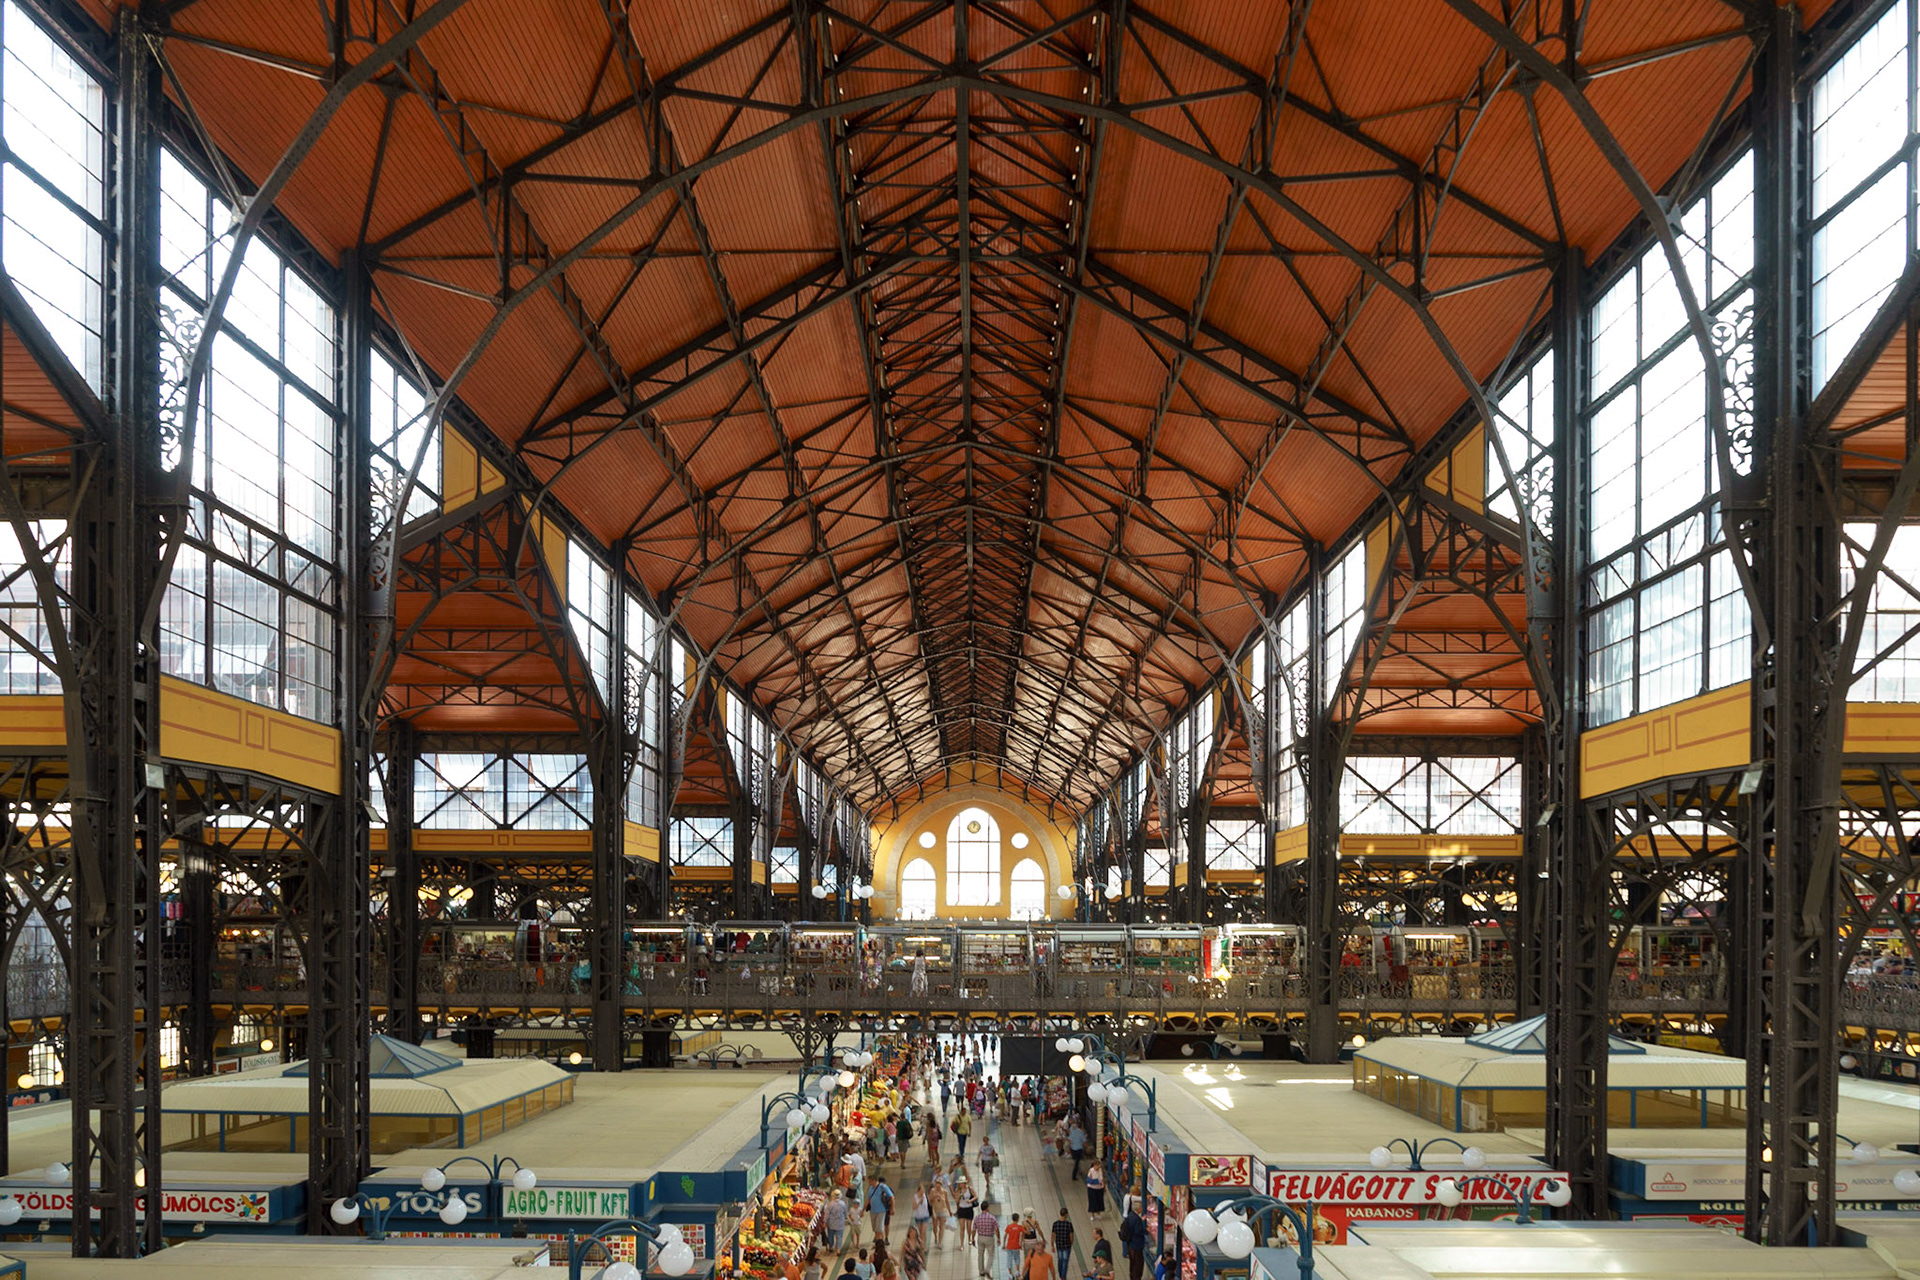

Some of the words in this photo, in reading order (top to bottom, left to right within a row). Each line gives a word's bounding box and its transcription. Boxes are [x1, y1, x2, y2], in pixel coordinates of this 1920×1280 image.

[1272, 1173, 1415, 1200] FELVÁGOTT
[135, 1193, 236, 1213] GÜMÖLCS
[506, 1189, 597, 1215] AGRO-FRUIT
[600, 1190, 629, 1216] KFT.
[1345, 1207, 1414, 1219] KABANOS
